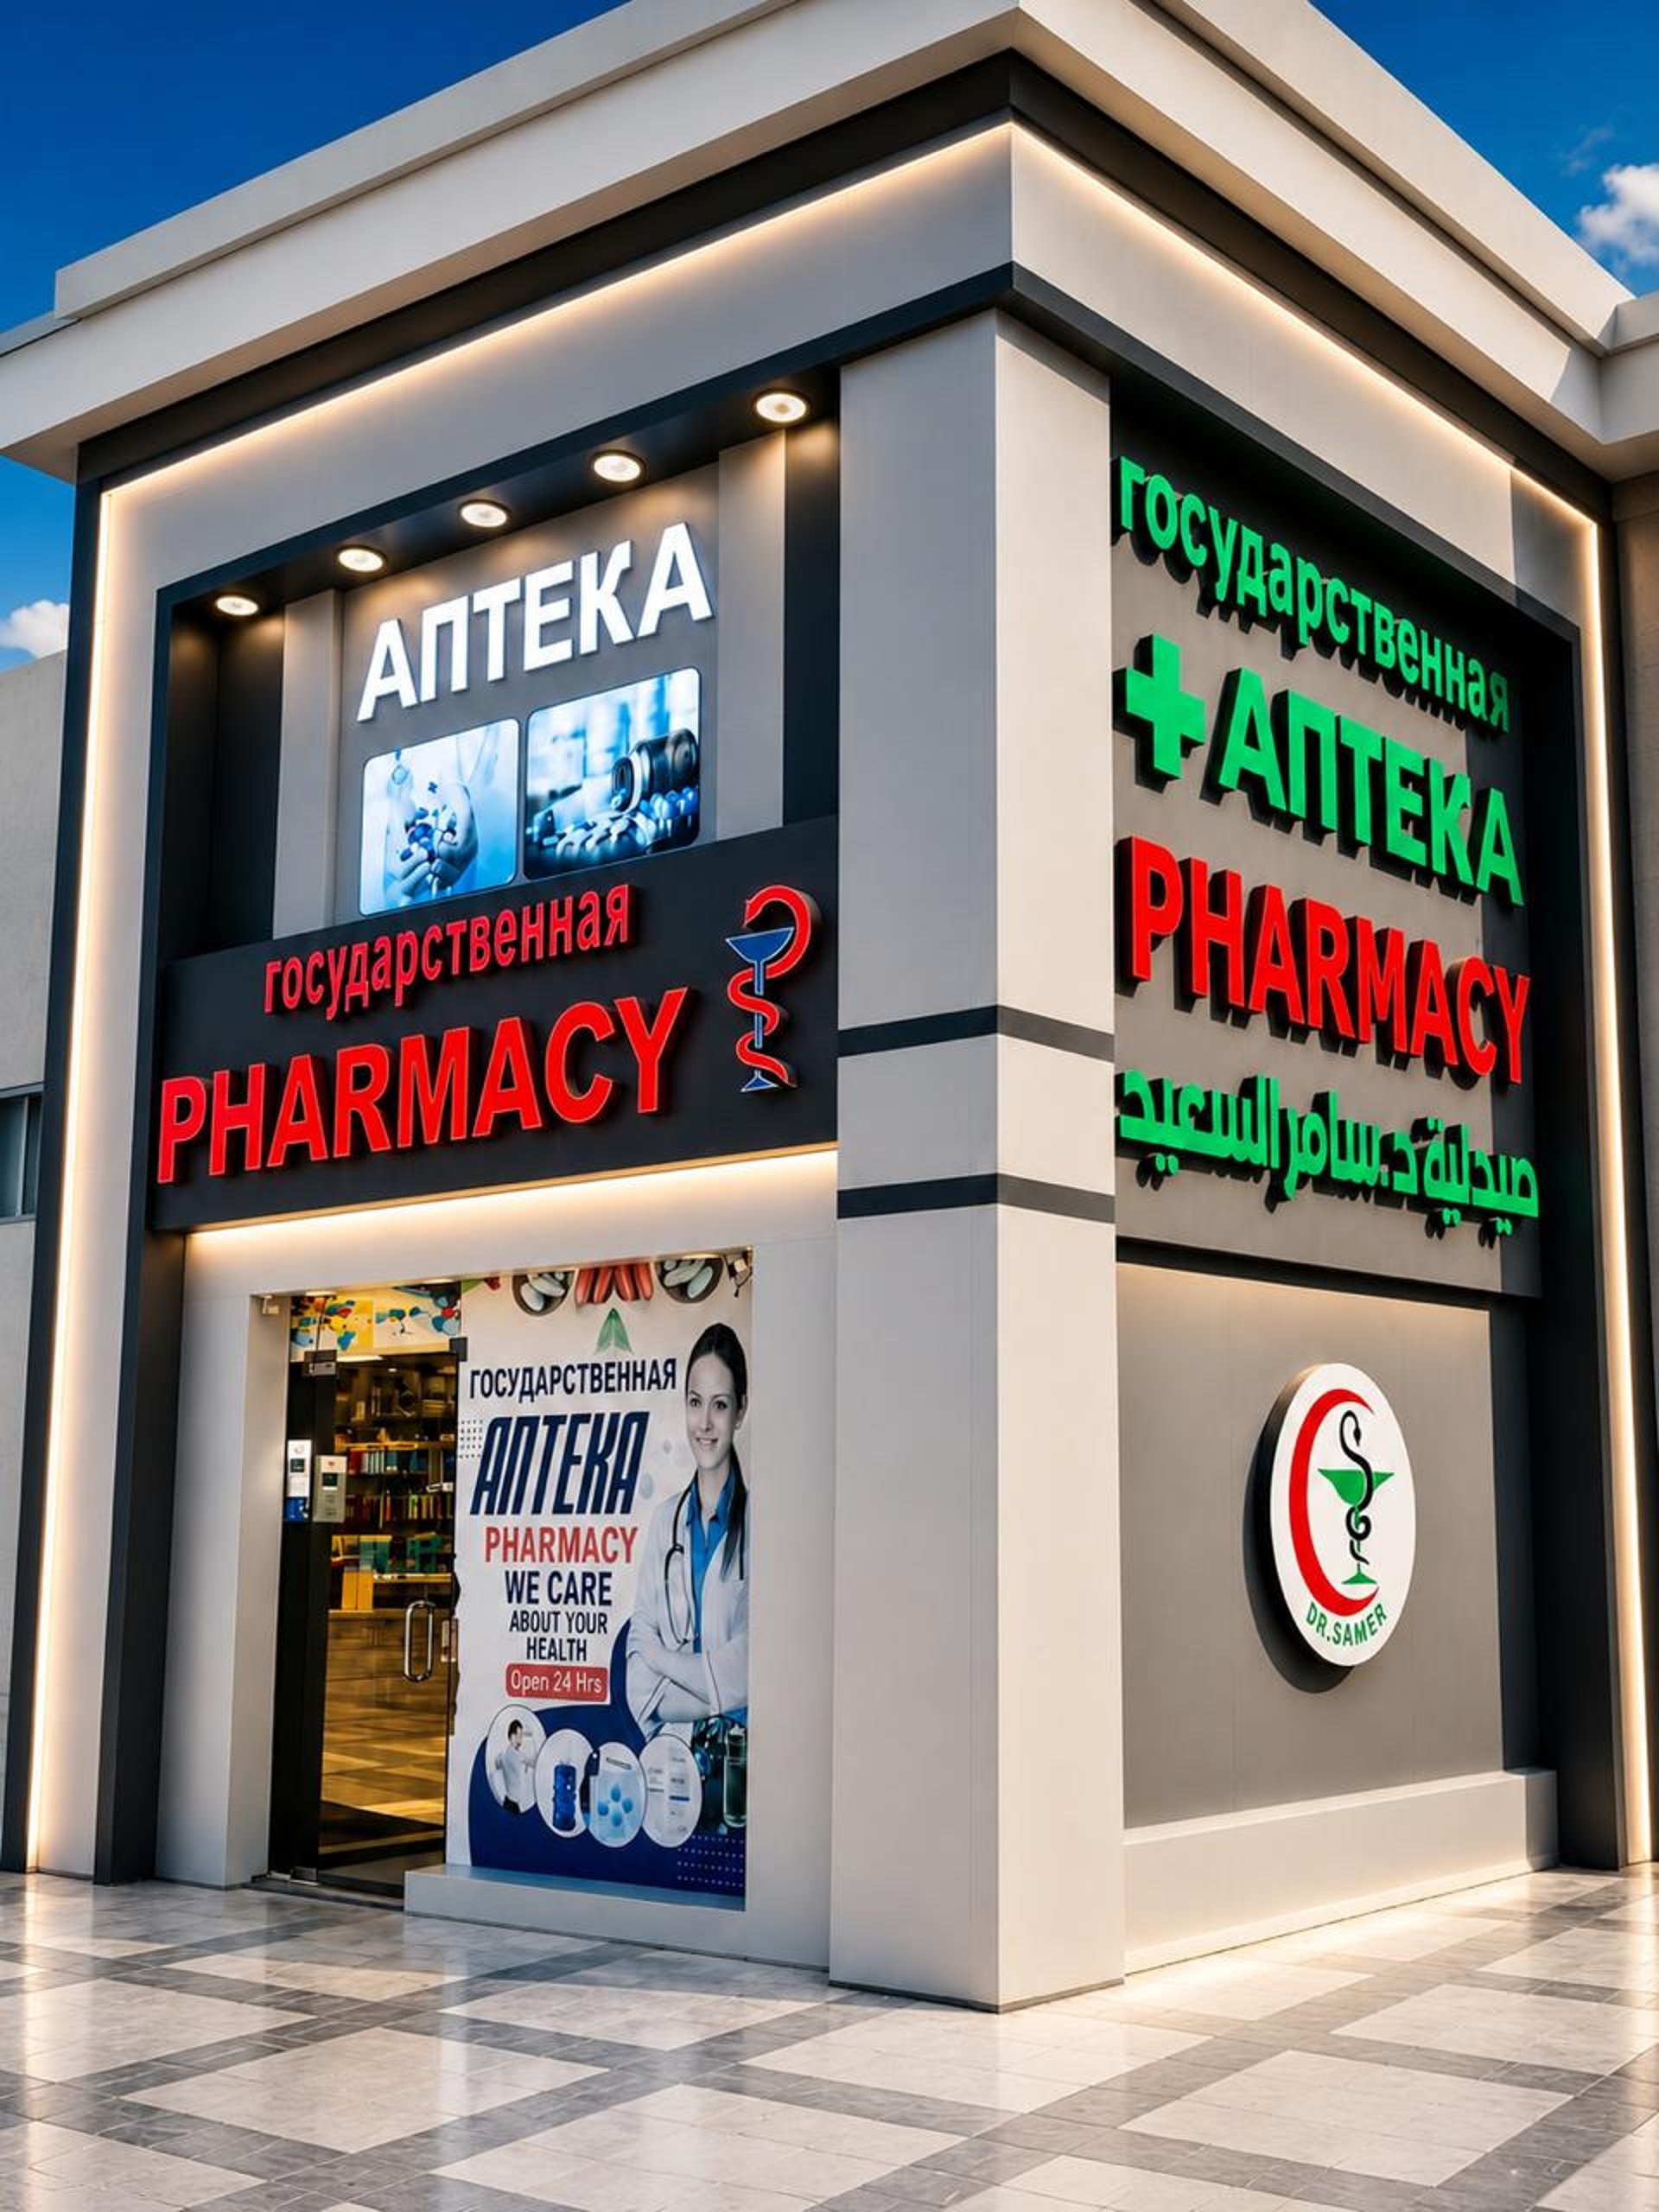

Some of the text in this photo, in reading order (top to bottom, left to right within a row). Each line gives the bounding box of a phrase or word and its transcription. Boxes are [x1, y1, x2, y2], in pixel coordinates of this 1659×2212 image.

[357, 522, 715, 721] АПТЕКА
[1120, 455, 1510, 734] государственная
[1218, 665, 1524, 906] АПТЕКА
[264, 884, 630, 1020] государственная
[1131, 836, 1529, 1084] PHARMACY
[156, 987, 689, 1184] PHARMACY
[469, 1358, 677, 1403] ГОСУДАРСТВЕННАЯ
[469, 1411, 651, 1516] АПТЕКА
[485, 1526, 639, 1564] PHARMACY
[505, 1570, 613, 1606] WE CARE
[509, 1610, 608, 1635] ABOUT YOUR
[525, 1637, 588, 1662] HEALTH
[510, 1669, 603, 1695] Open 24 Hrs
